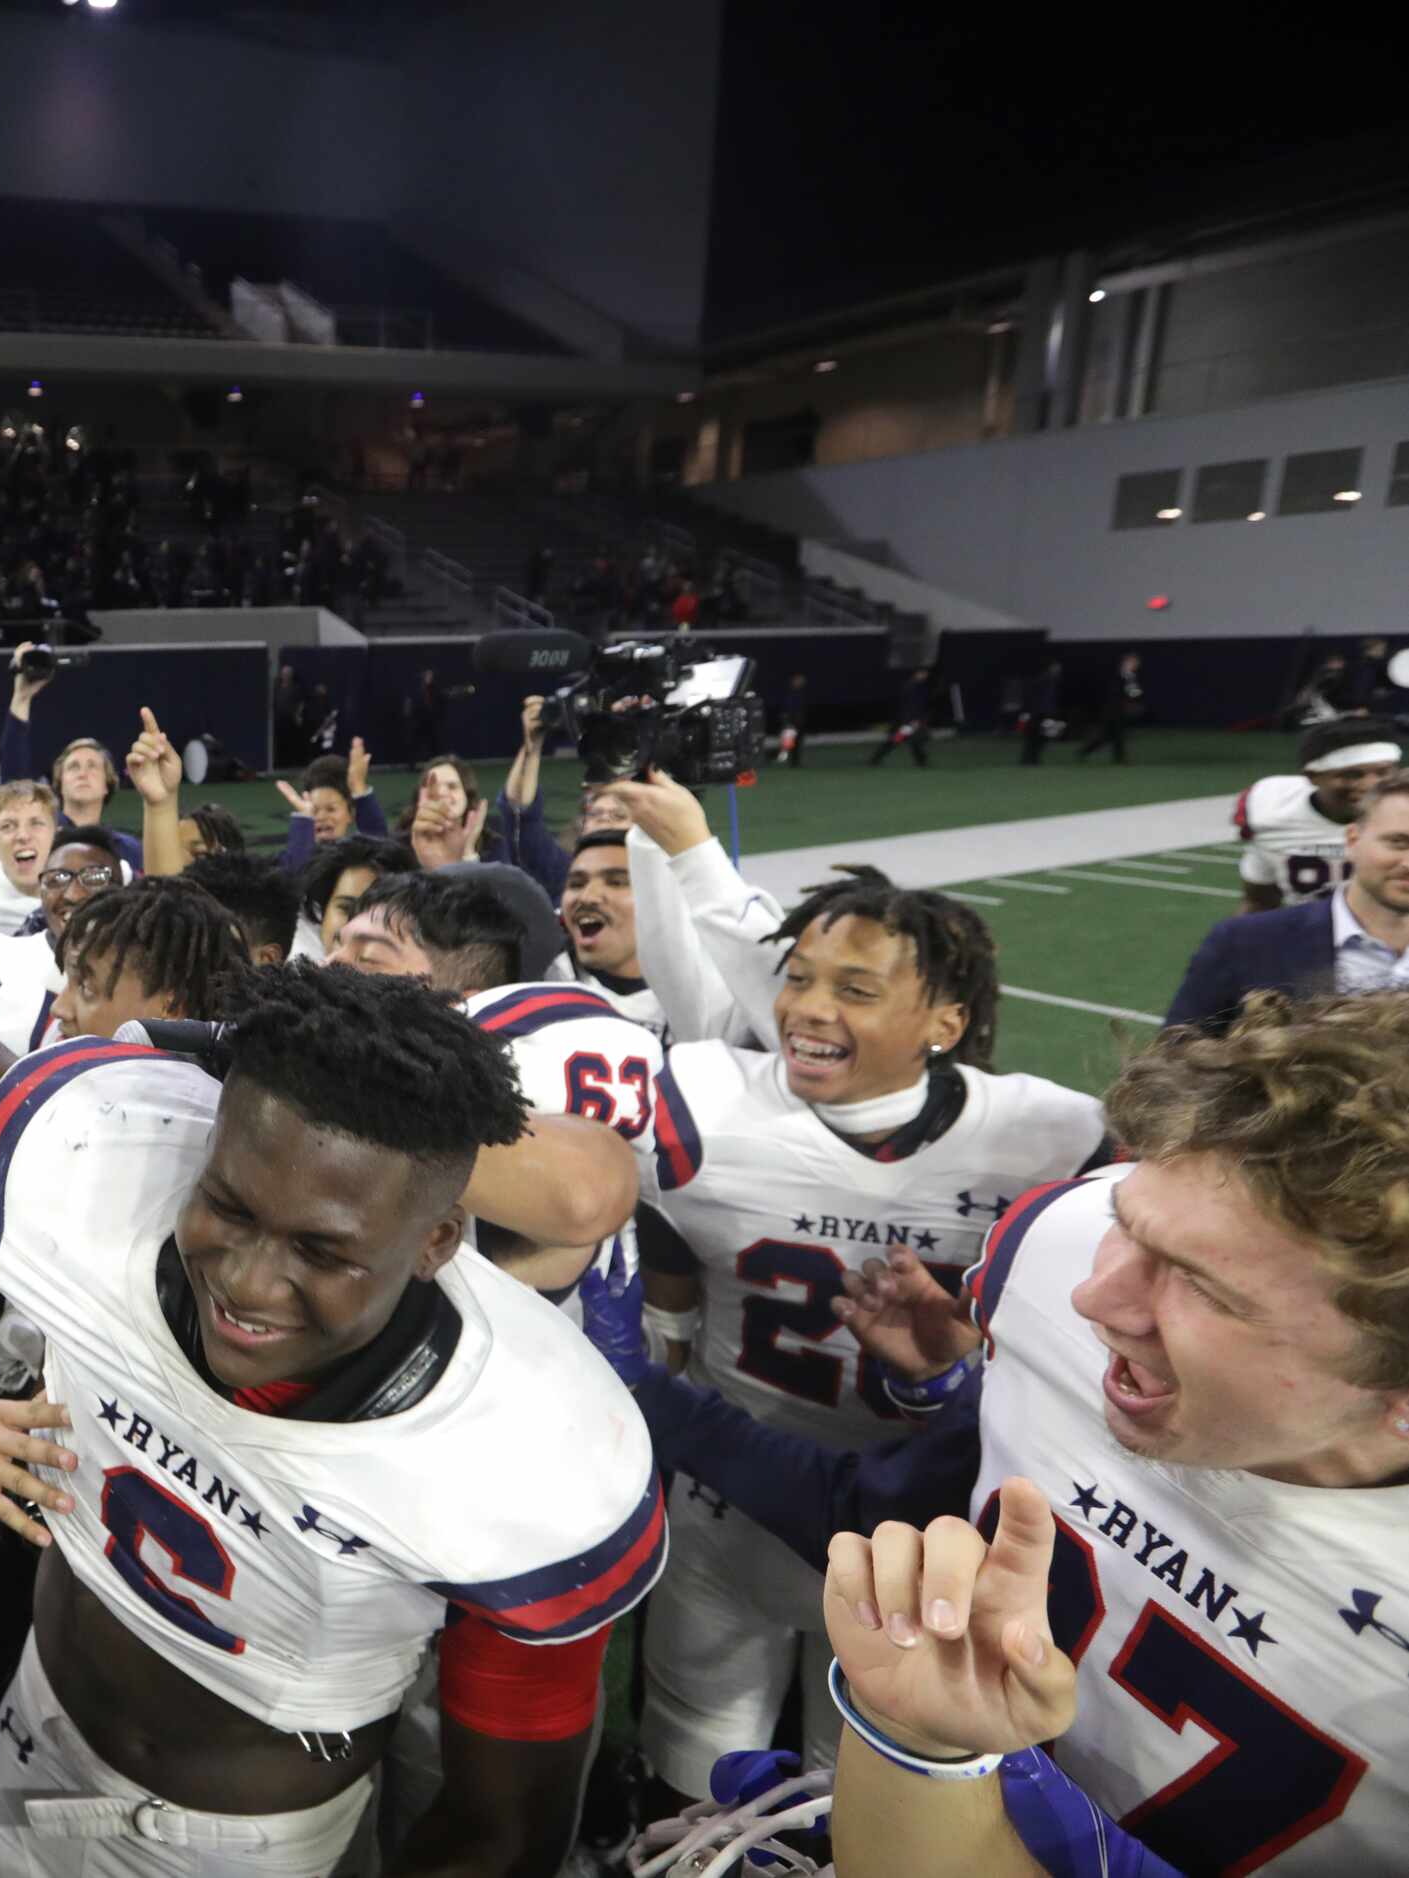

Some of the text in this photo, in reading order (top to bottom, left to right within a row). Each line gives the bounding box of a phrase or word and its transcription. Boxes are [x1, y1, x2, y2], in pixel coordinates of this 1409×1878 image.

[563, 1050, 652, 1141] 63
[818, 1215, 911, 1246] RYAN
[122, 1412, 240, 1516] RYAN
[1097, 1499, 1239, 1622] RYAN
